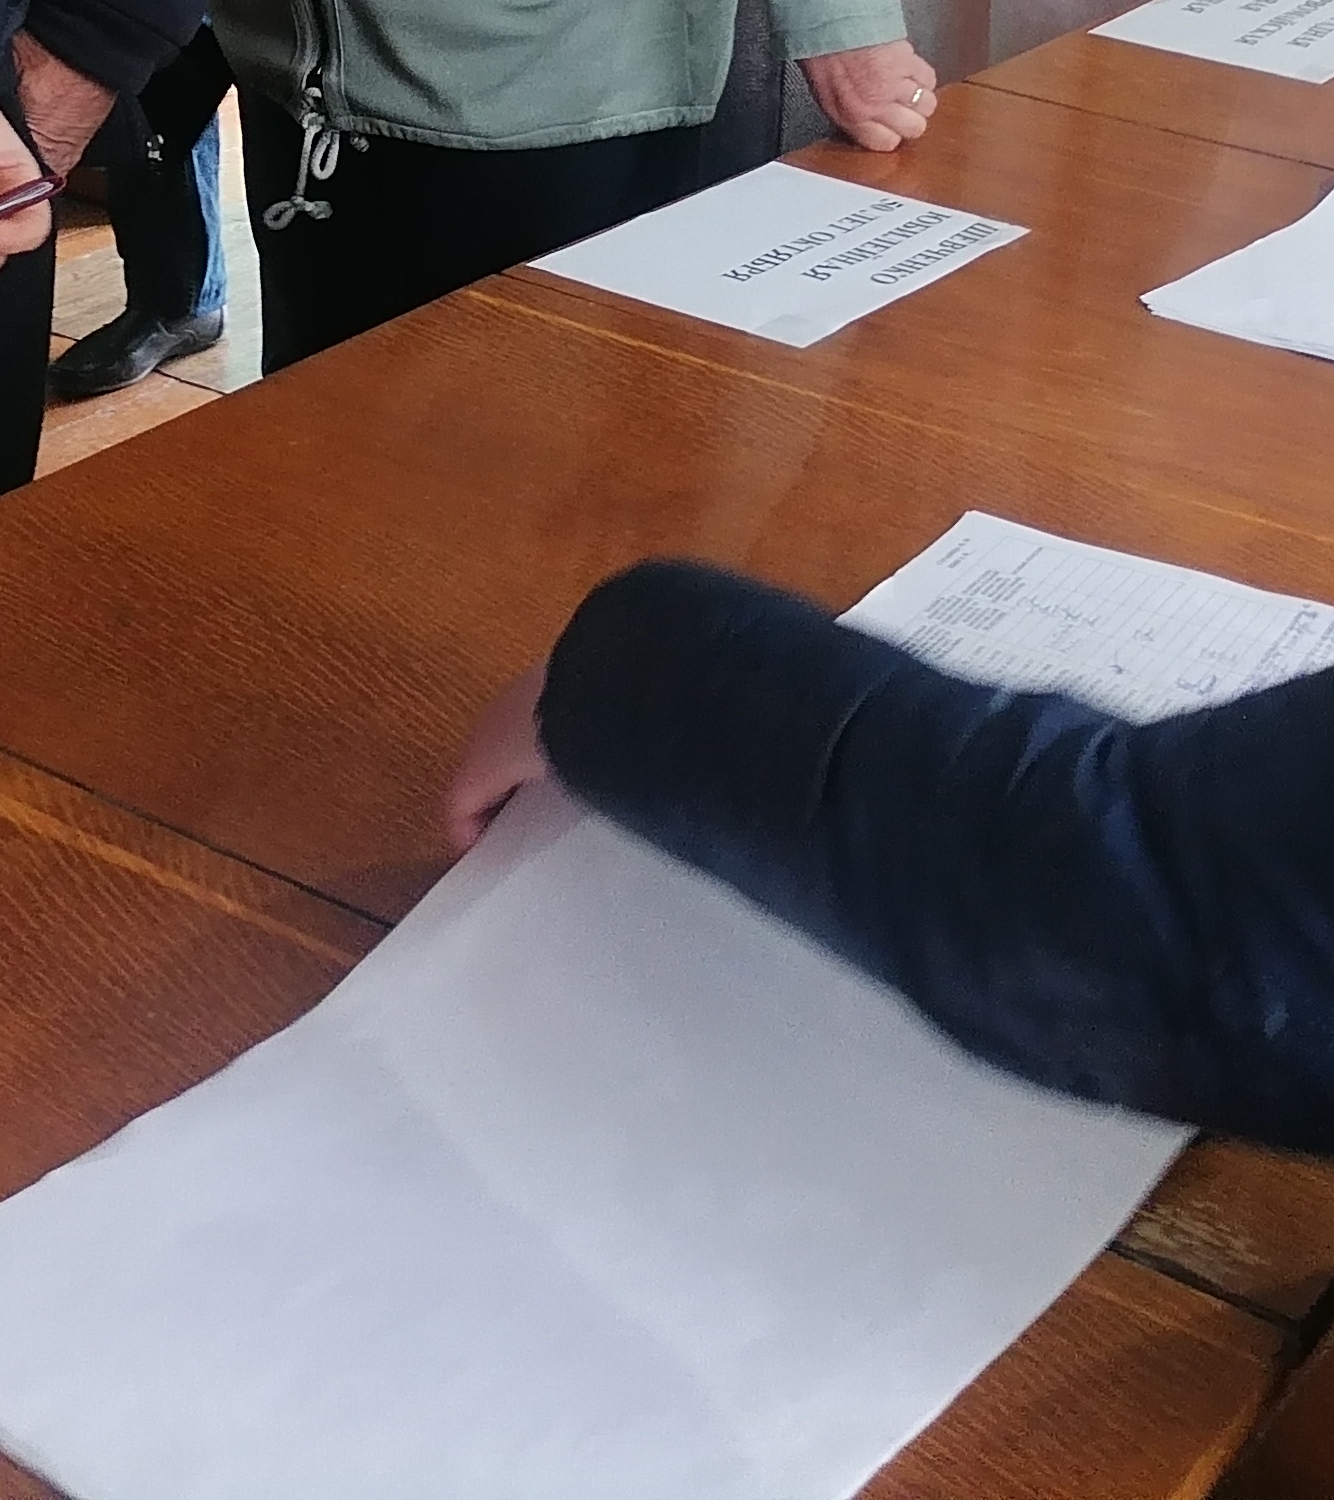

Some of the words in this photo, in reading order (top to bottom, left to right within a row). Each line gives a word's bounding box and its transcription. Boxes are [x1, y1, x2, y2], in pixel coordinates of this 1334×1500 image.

[827, 208, 882, 234] ЛЕТ
[871, 198, 905, 213] 50
[720, 231, 836, 283] ОКТЯБРЯ
[799, 210, 953, 282] ЮБИЛЕЙНАЯ
[869, 221, 1000, 286] ШЕВЧЕНКО
